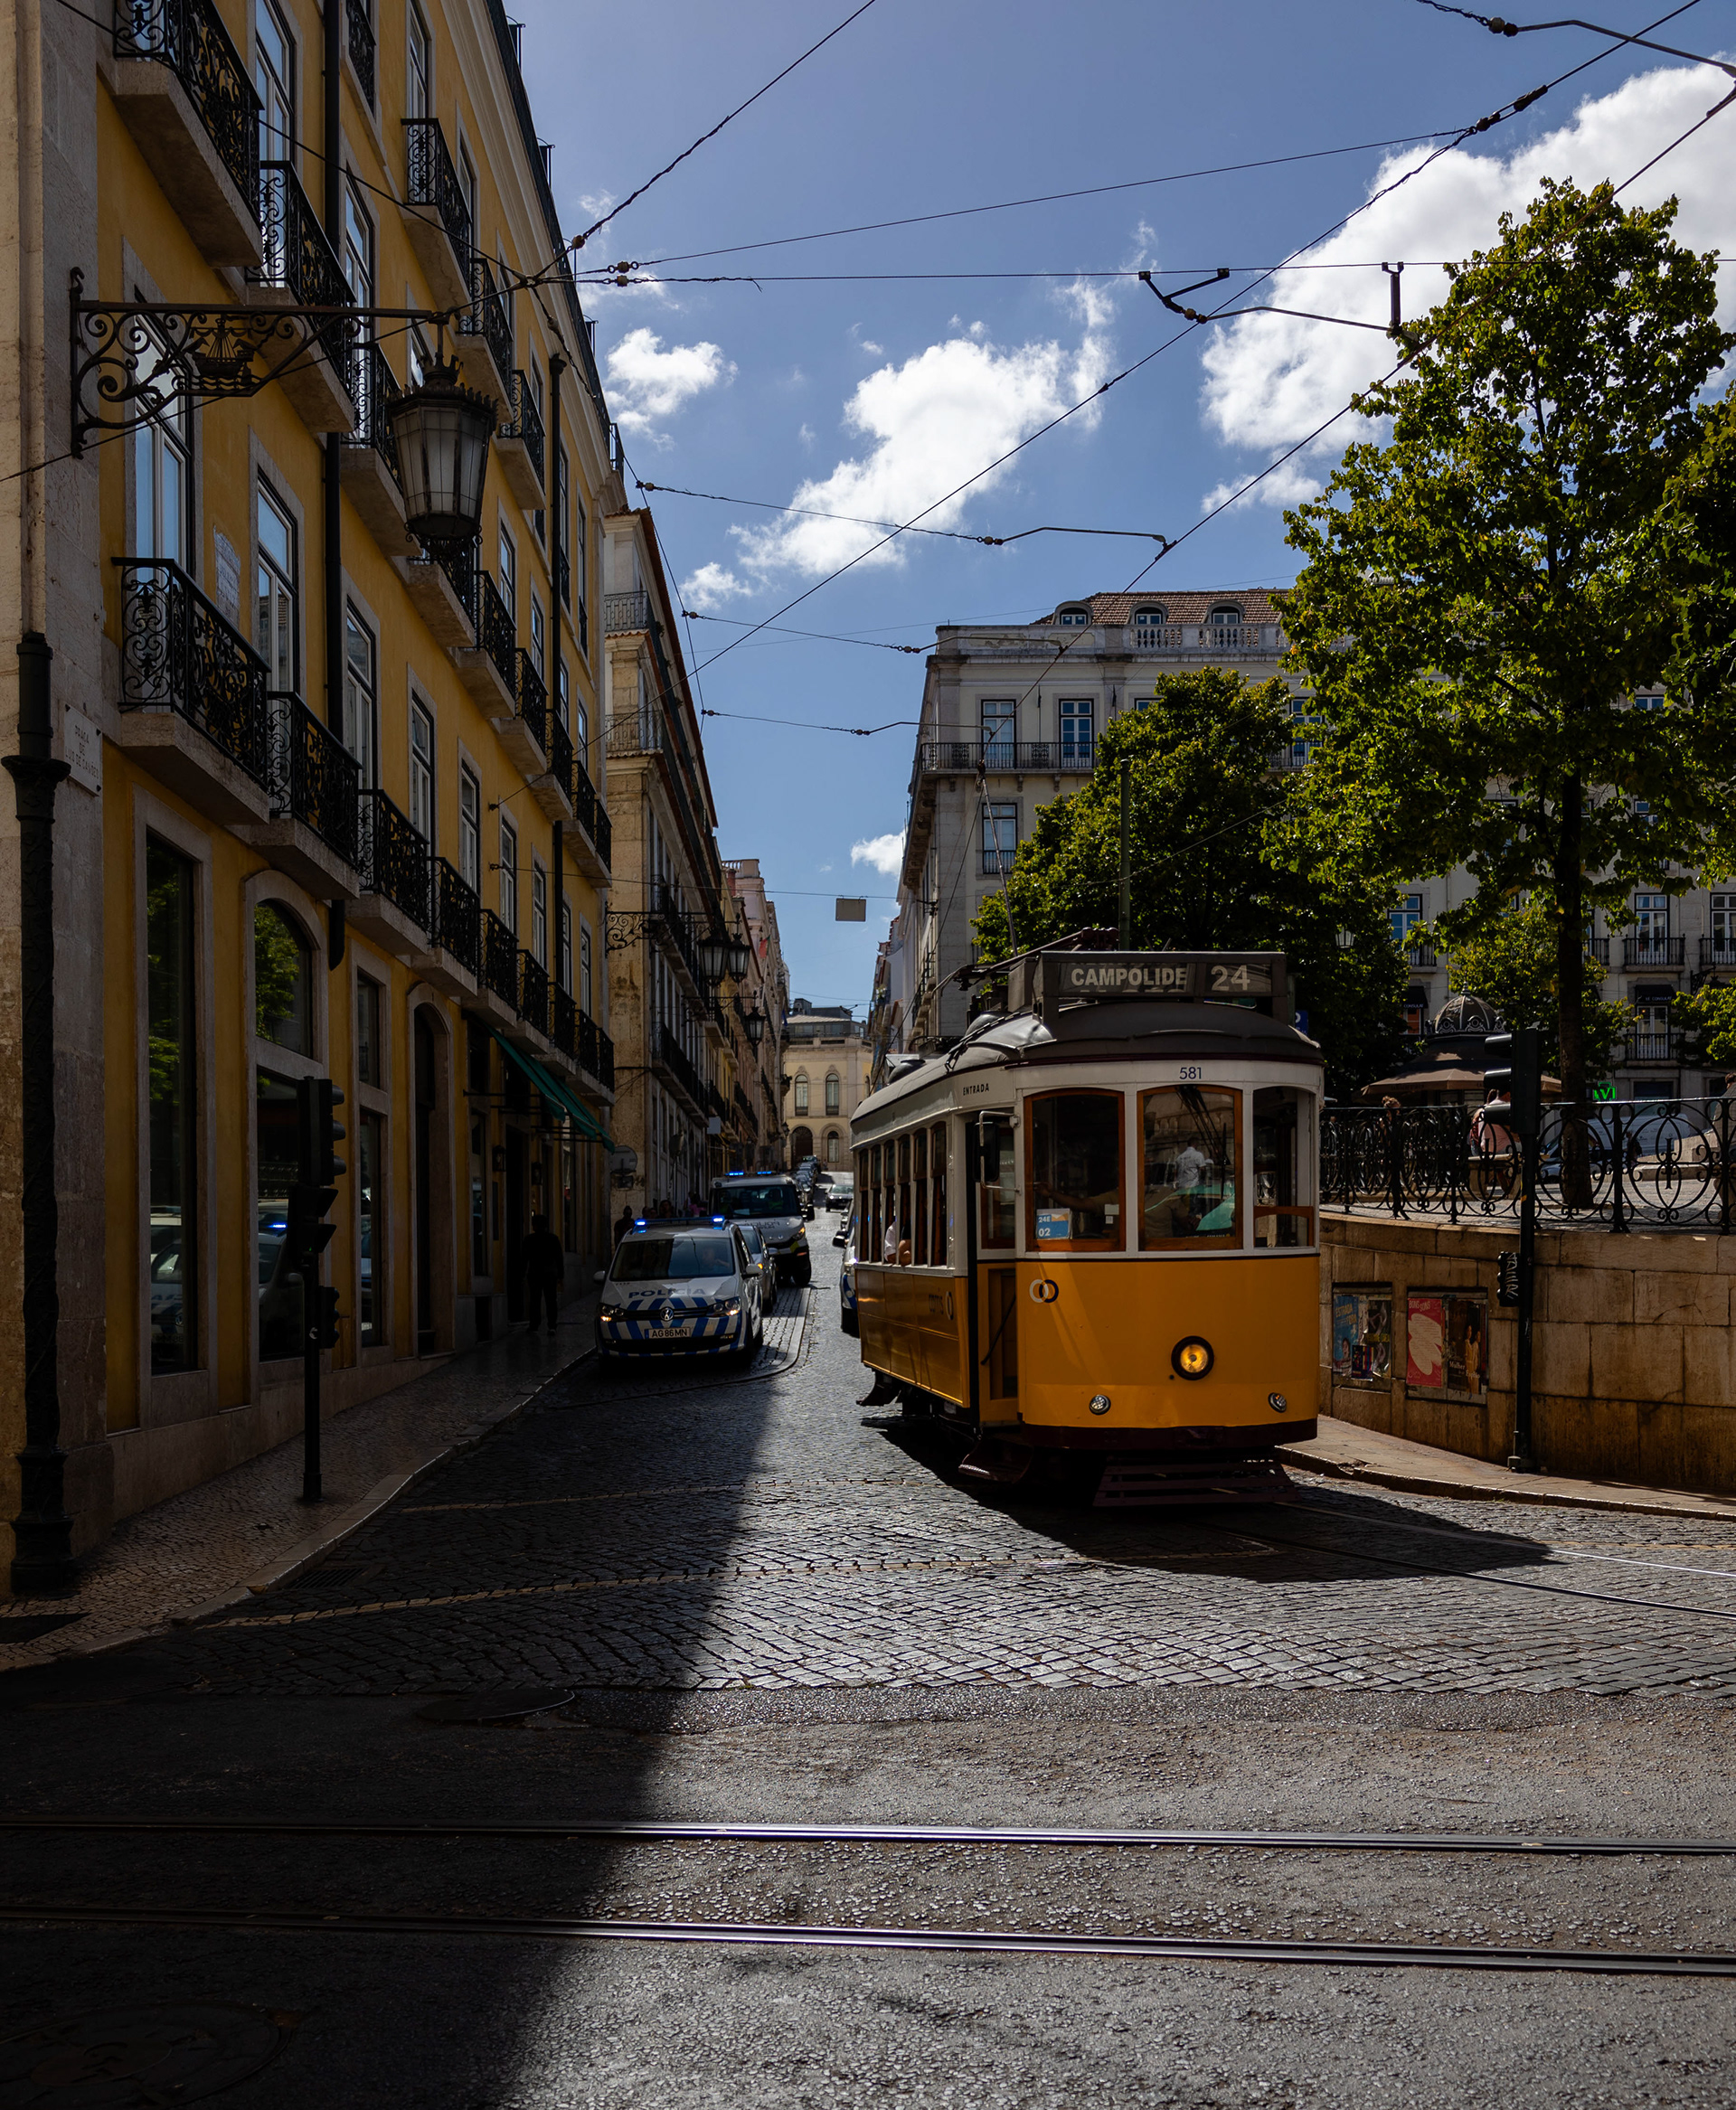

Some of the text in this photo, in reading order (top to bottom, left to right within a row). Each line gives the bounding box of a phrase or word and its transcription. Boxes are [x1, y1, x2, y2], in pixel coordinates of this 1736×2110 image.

[1071, 965, 1250, 992] CAMPOLIDE 24
[1179, 1067, 1203, 1080] 581
[963, 1083, 990, 1097] ENTRADA
[1038, 1215, 1051, 1223] 24E
[1038, 1228, 1051, 1237] 02
